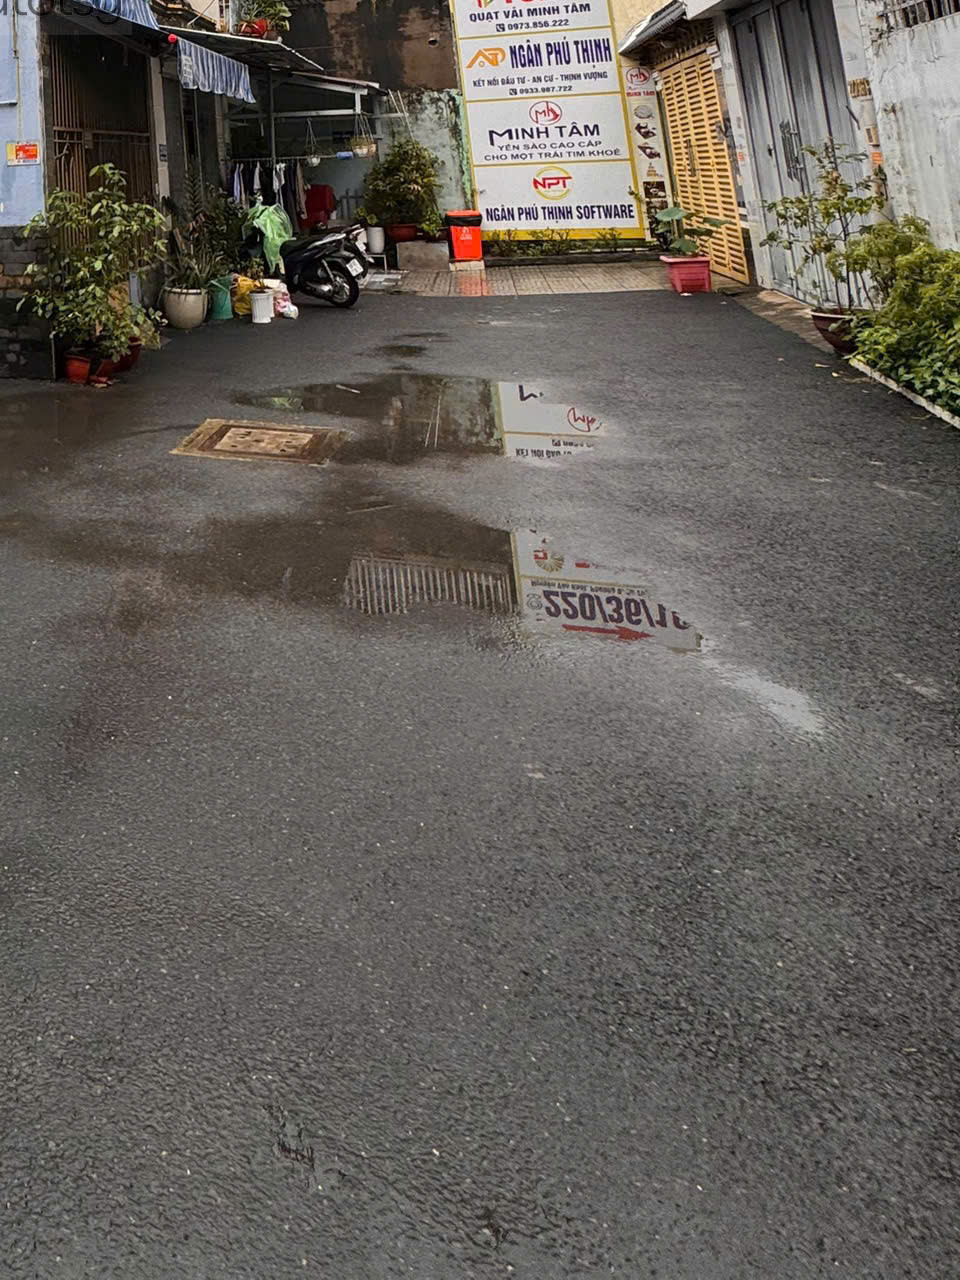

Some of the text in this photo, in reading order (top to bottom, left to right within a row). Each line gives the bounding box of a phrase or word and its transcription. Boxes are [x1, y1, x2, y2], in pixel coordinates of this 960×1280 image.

[469, 11, 500, 22] QUẠT
[527, 6, 560, 17] MINH
[563, 3, 591, 14] TÂM
[509, 36, 613, 69] NGÂN PHÚ THỊNH
[532, 75, 542, 84] AN
[488, 121, 600, 146] MINH TÂM
[522, 141, 547, 150] SÀO
[538, 150, 563, 159] TRÁI
[566, 150, 585, 158] TIM
[485, 204, 515, 222] NGÂN
[541, 205, 573, 224] THỊNH
[576, 204, 635, 220] SOFTWARE
